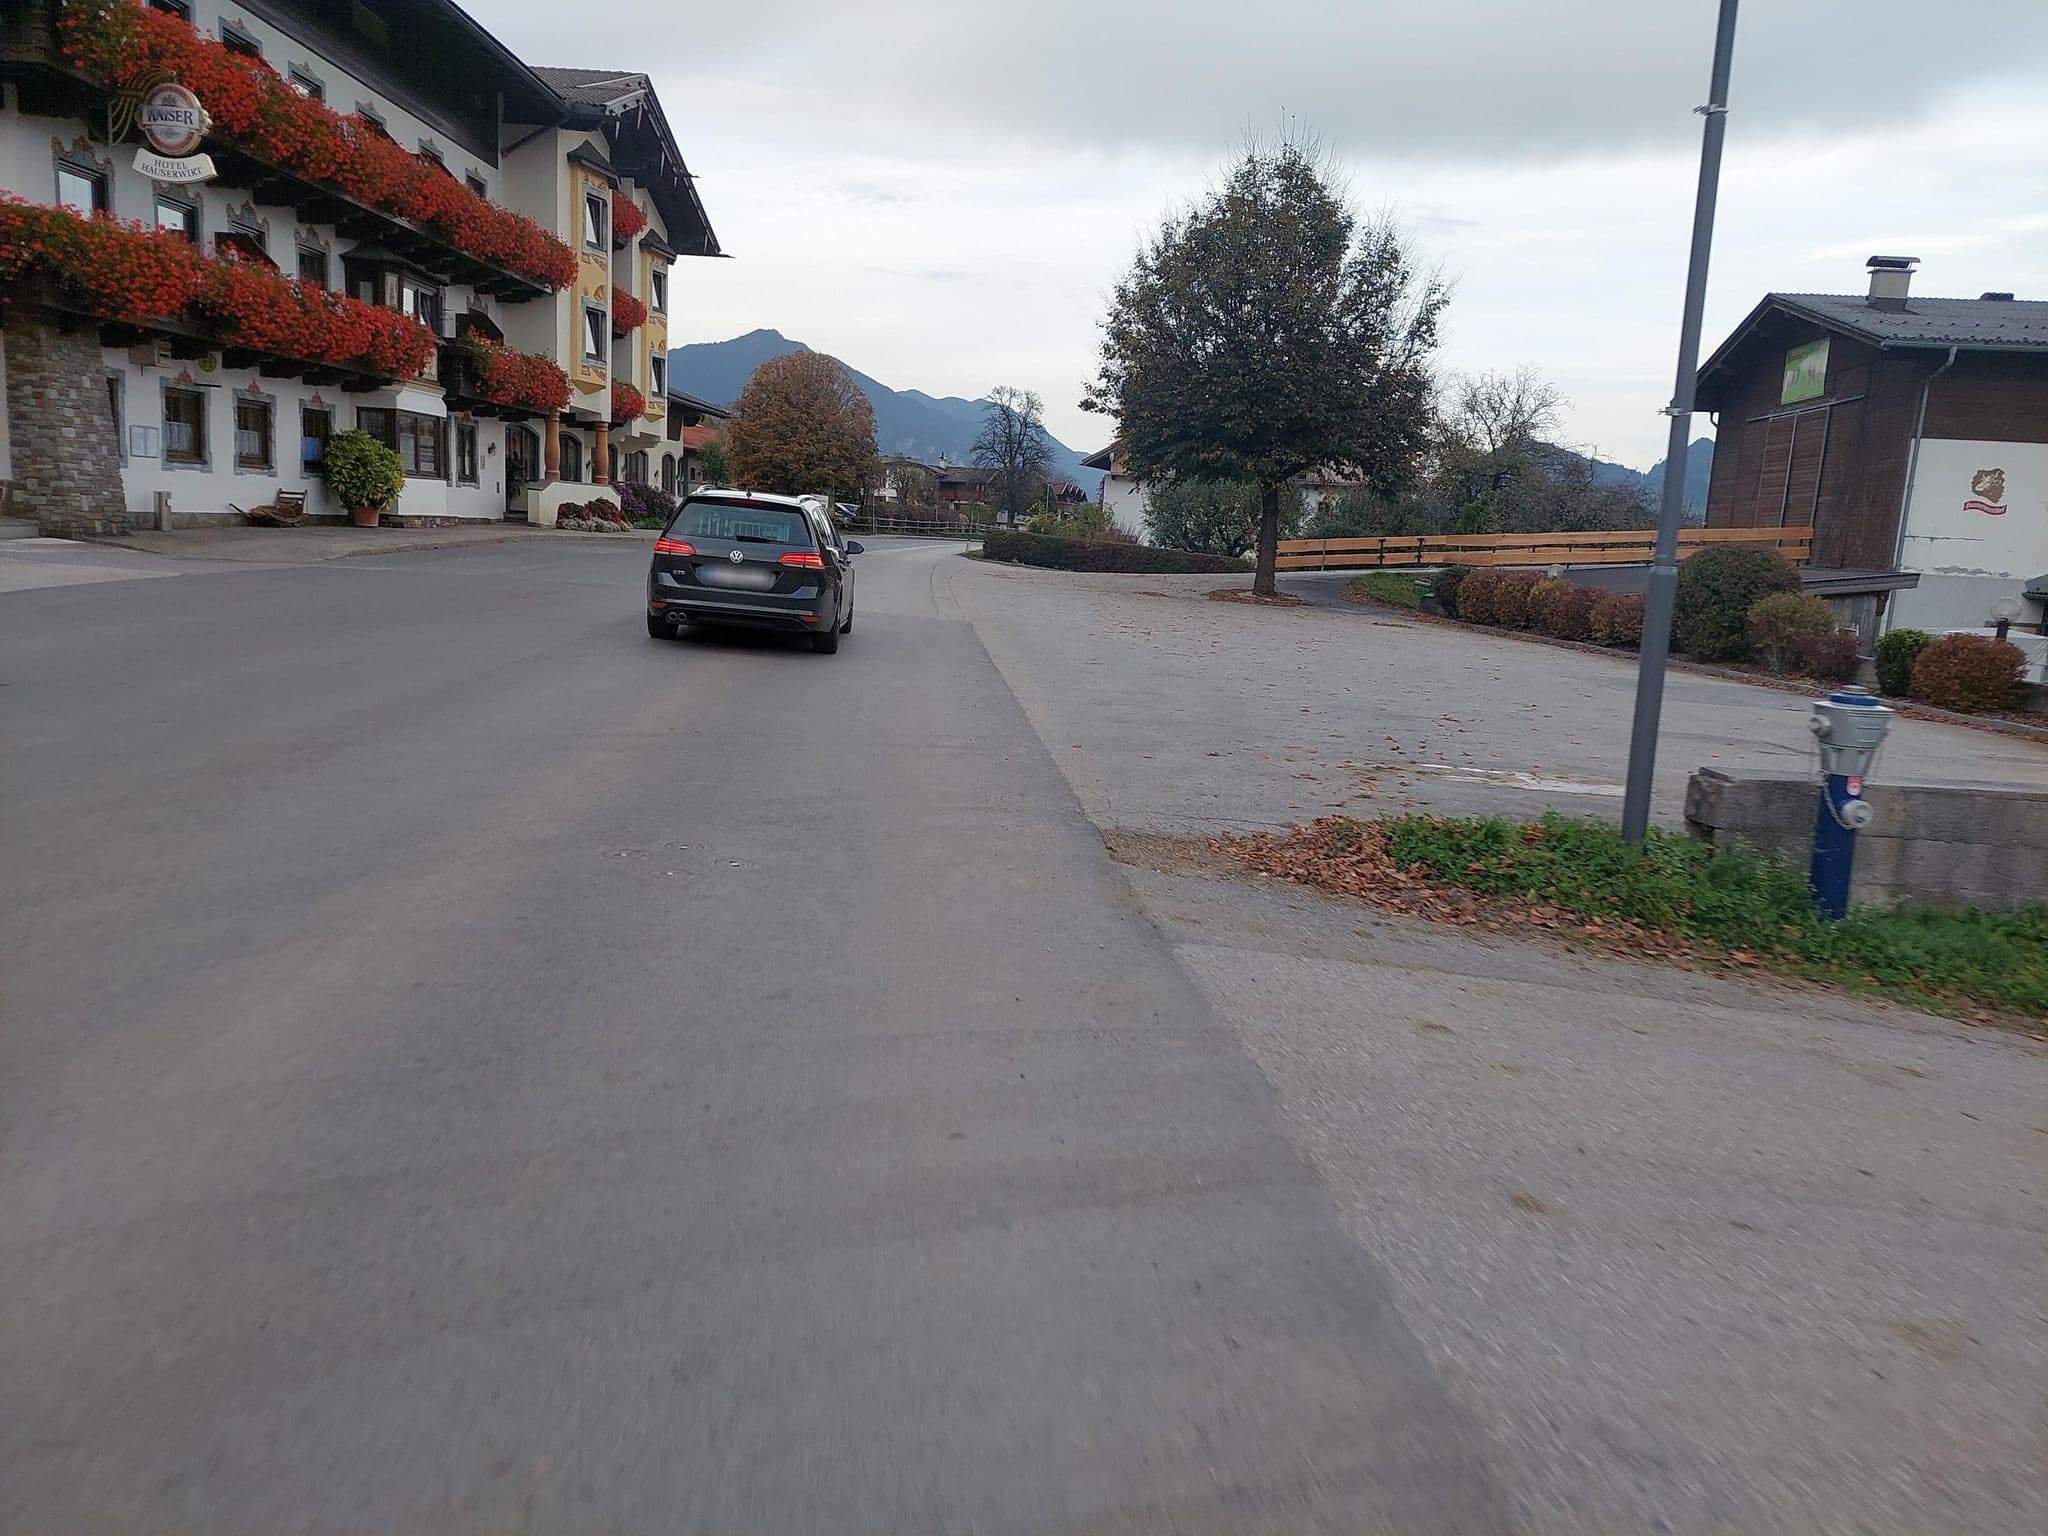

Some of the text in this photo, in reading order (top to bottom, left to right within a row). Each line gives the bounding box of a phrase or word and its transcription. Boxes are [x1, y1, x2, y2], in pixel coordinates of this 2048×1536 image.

[148, 109, 193, 125] KAISER
[141, 163, 202, 178] HAUSERWIRT
[154, 159, 189, 170] HOTEL
